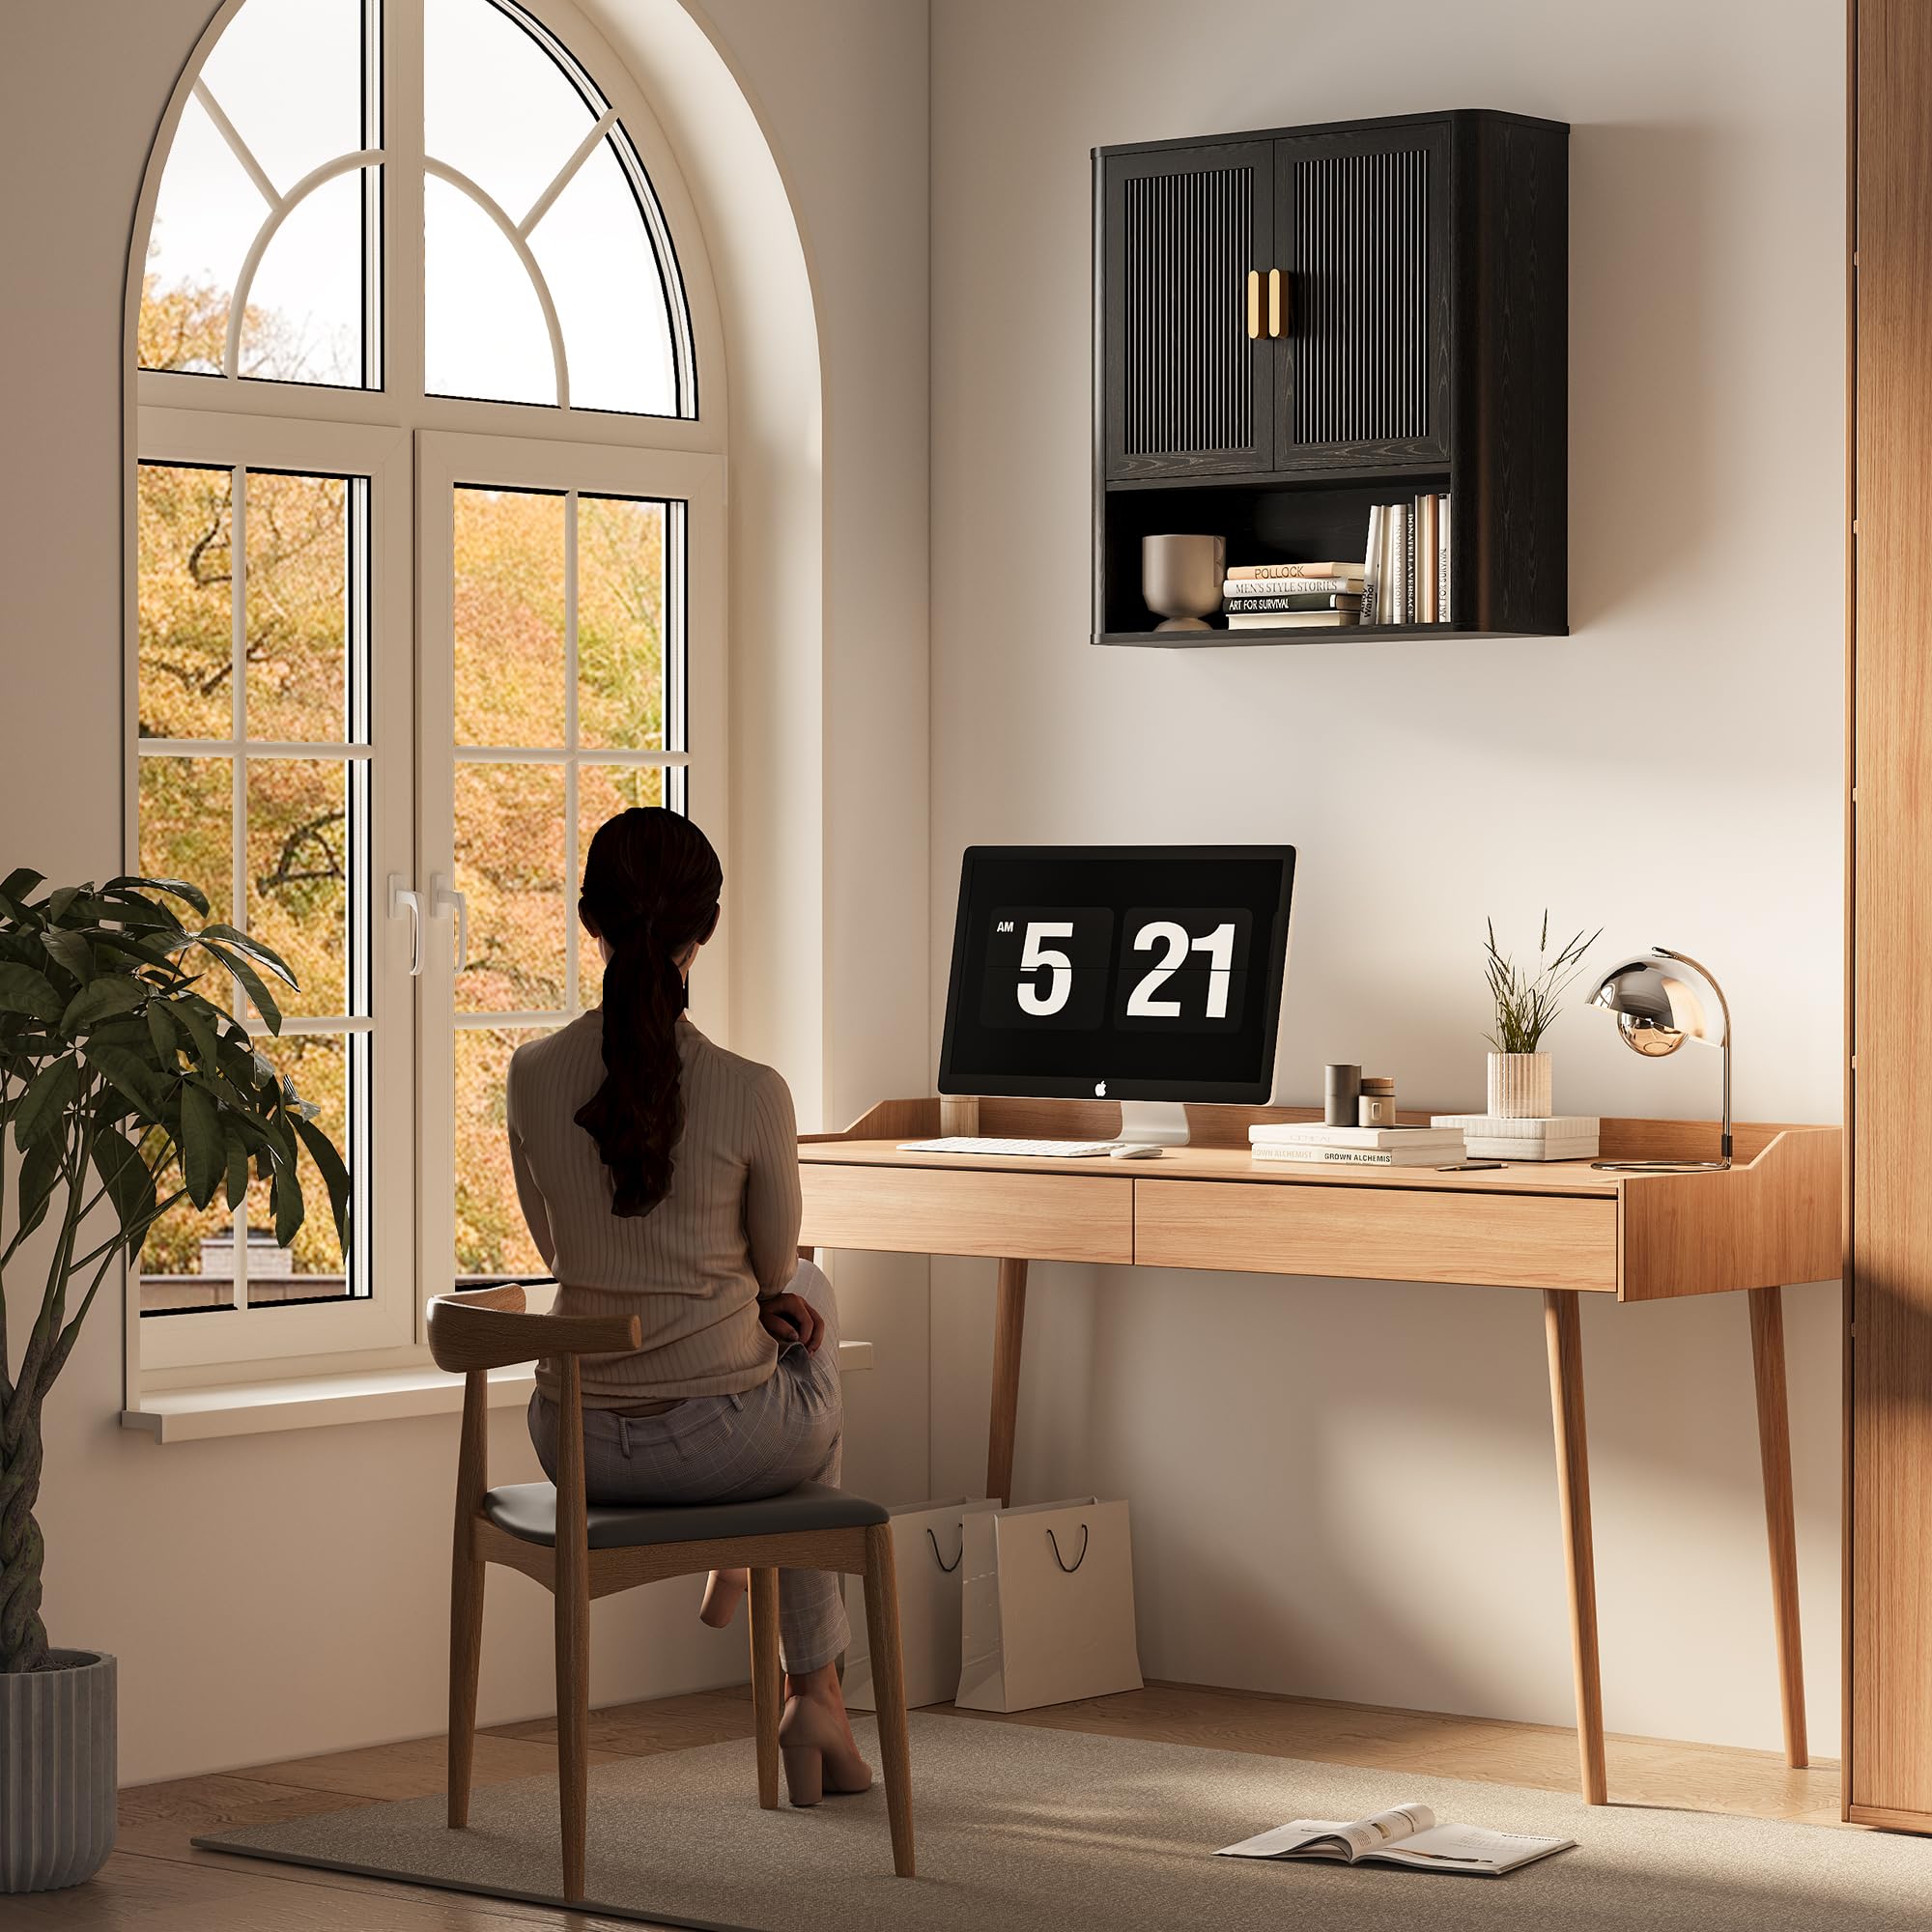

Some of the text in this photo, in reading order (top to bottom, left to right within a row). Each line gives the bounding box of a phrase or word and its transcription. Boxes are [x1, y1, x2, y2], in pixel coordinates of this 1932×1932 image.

[1254, 565, 1305, 579] POLLOCK
[1236, 580, 1338, 594] MEN'S STYLE STORIES
[1438, 548, 1447, 618] ART FOR SURVIVAL
[1229, 598, 1290, 611] ART FOR SURVIVAL
[1364, 583, 1375, 618] Warhol
[996, 921, 1236, 1018] AM 5 21
[1324, 1152, 1351, 1161] GROWN
